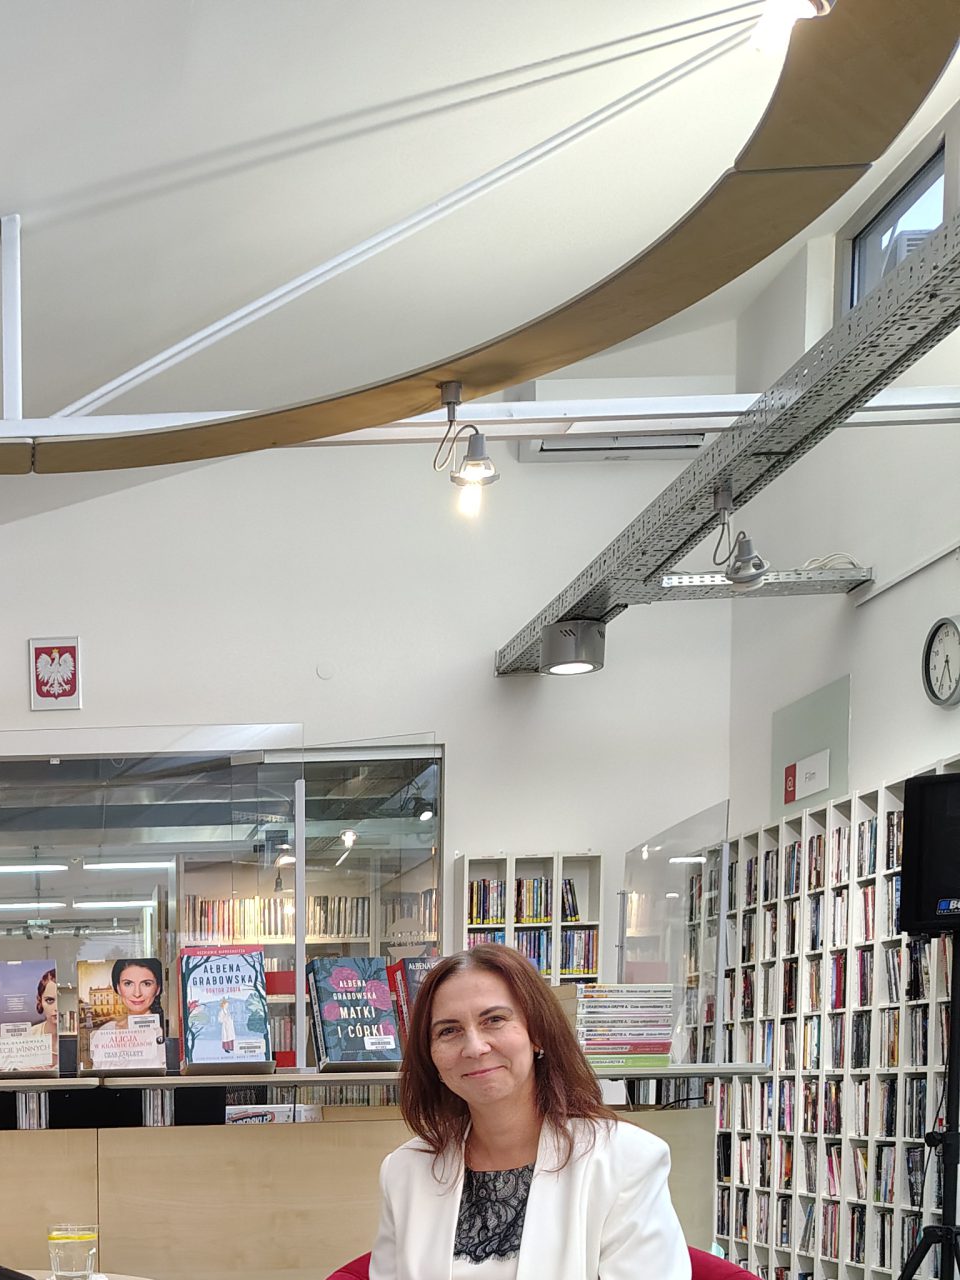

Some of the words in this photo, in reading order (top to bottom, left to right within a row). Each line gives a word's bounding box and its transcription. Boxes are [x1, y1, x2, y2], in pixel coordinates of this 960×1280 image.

[203, 963, 241, 974] AŁBENA
[192, 974, 253, 986] GRABOWSKA
[339, 980, 367, 988] AŁBENA
[332, 991, 377, 1000] GRABOWSKA
[340, 1006, 376, 1019] MATKI
[337, 1026, 342, 1038] I
[347, 1023, 384, 1038] CÓRKI
